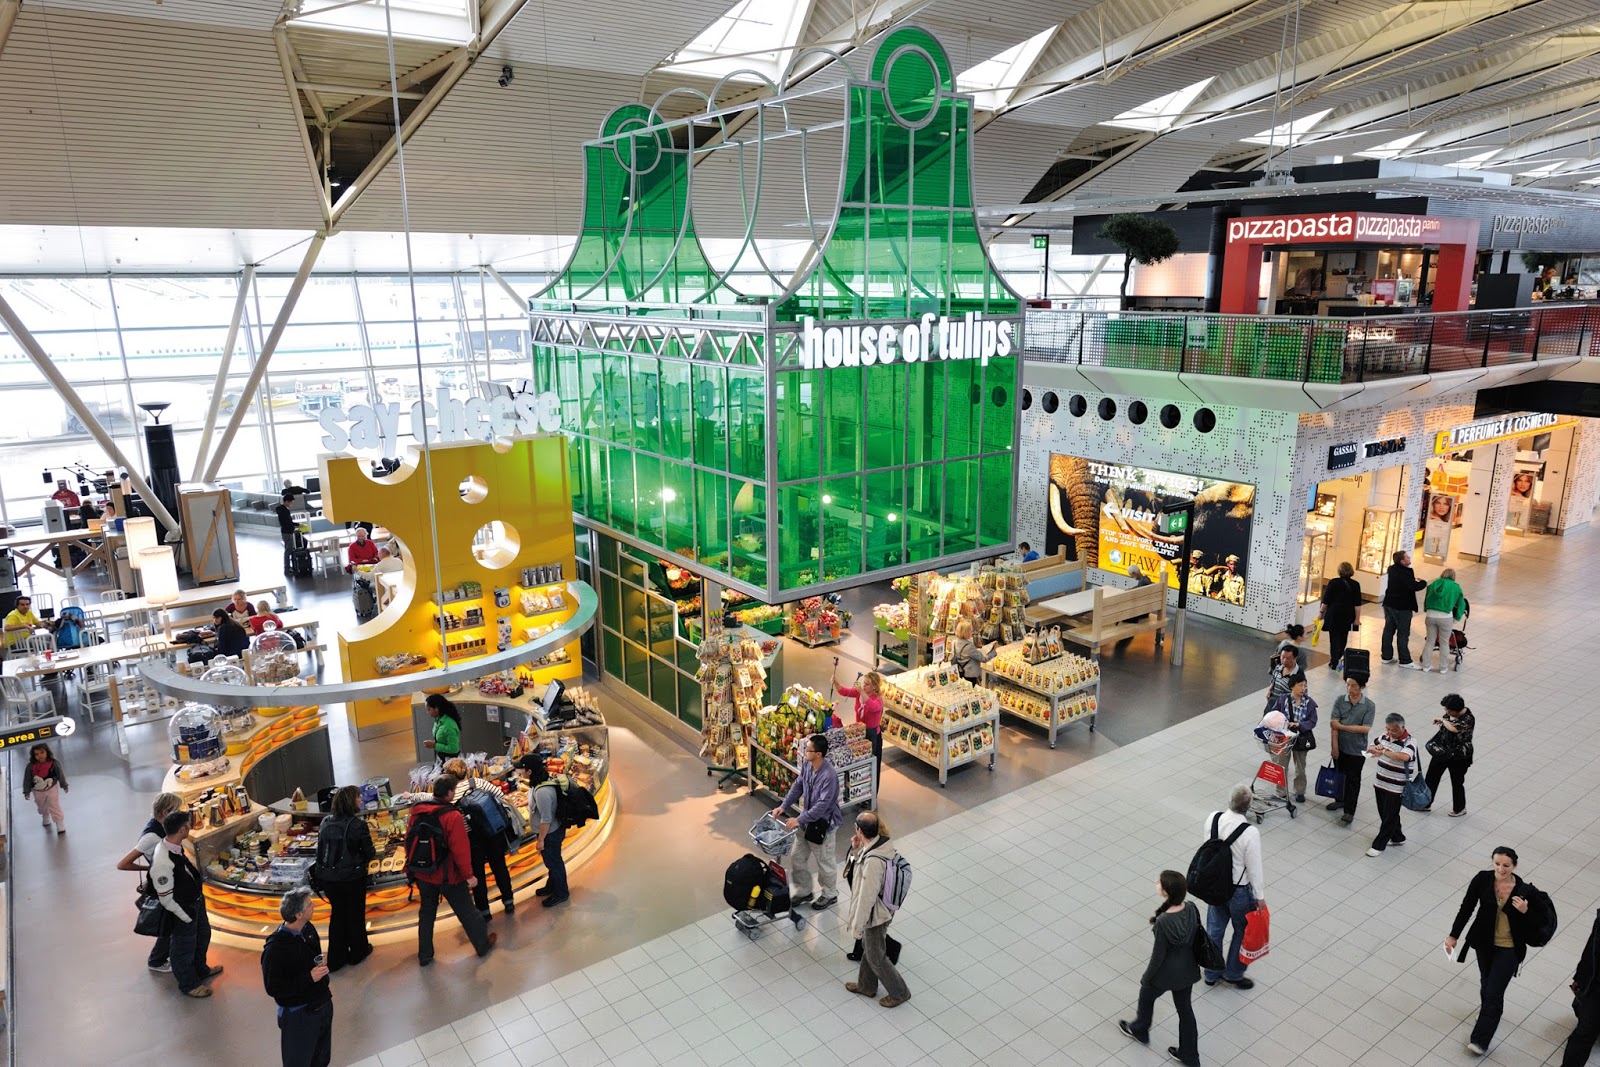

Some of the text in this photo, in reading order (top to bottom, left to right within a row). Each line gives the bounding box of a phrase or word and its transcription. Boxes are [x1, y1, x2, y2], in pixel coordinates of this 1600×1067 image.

[1229, 213, 1352, 243] pizzapasta
[1356, 215, 1441, 241] pizzapasta panini
[1494, 213, 1549, 234] pizzapasta
[804, 310, 1012, 369] house of tulips
[319, 401, 400, 458] say
[411, 387, 561, 443] cheese
[1458, 423, 1505, 444] PERFUMES
[1506, 420, 1513, 434] &
[1514, 413, 1558, 432] COSMETICS
[1333, 443, 1358, 457] GASSAN
[1088, 462, 1204, 493] THINK TWICE!
[1094, 475, 1113, 484] Don't
[1129, 480, 1156, 492] wildlife
[1121, 507, 1156, 523] VISIT
[1100, 528, 1180, 552] STOP THE IVORY TRADE
[1119, 539, 1138, 548] SAVE
[1139, 543, 1175, 557] WILDLIFE!
[1122, 551, 1160, 573] IFAW
[8, 732, 35, 744] area
